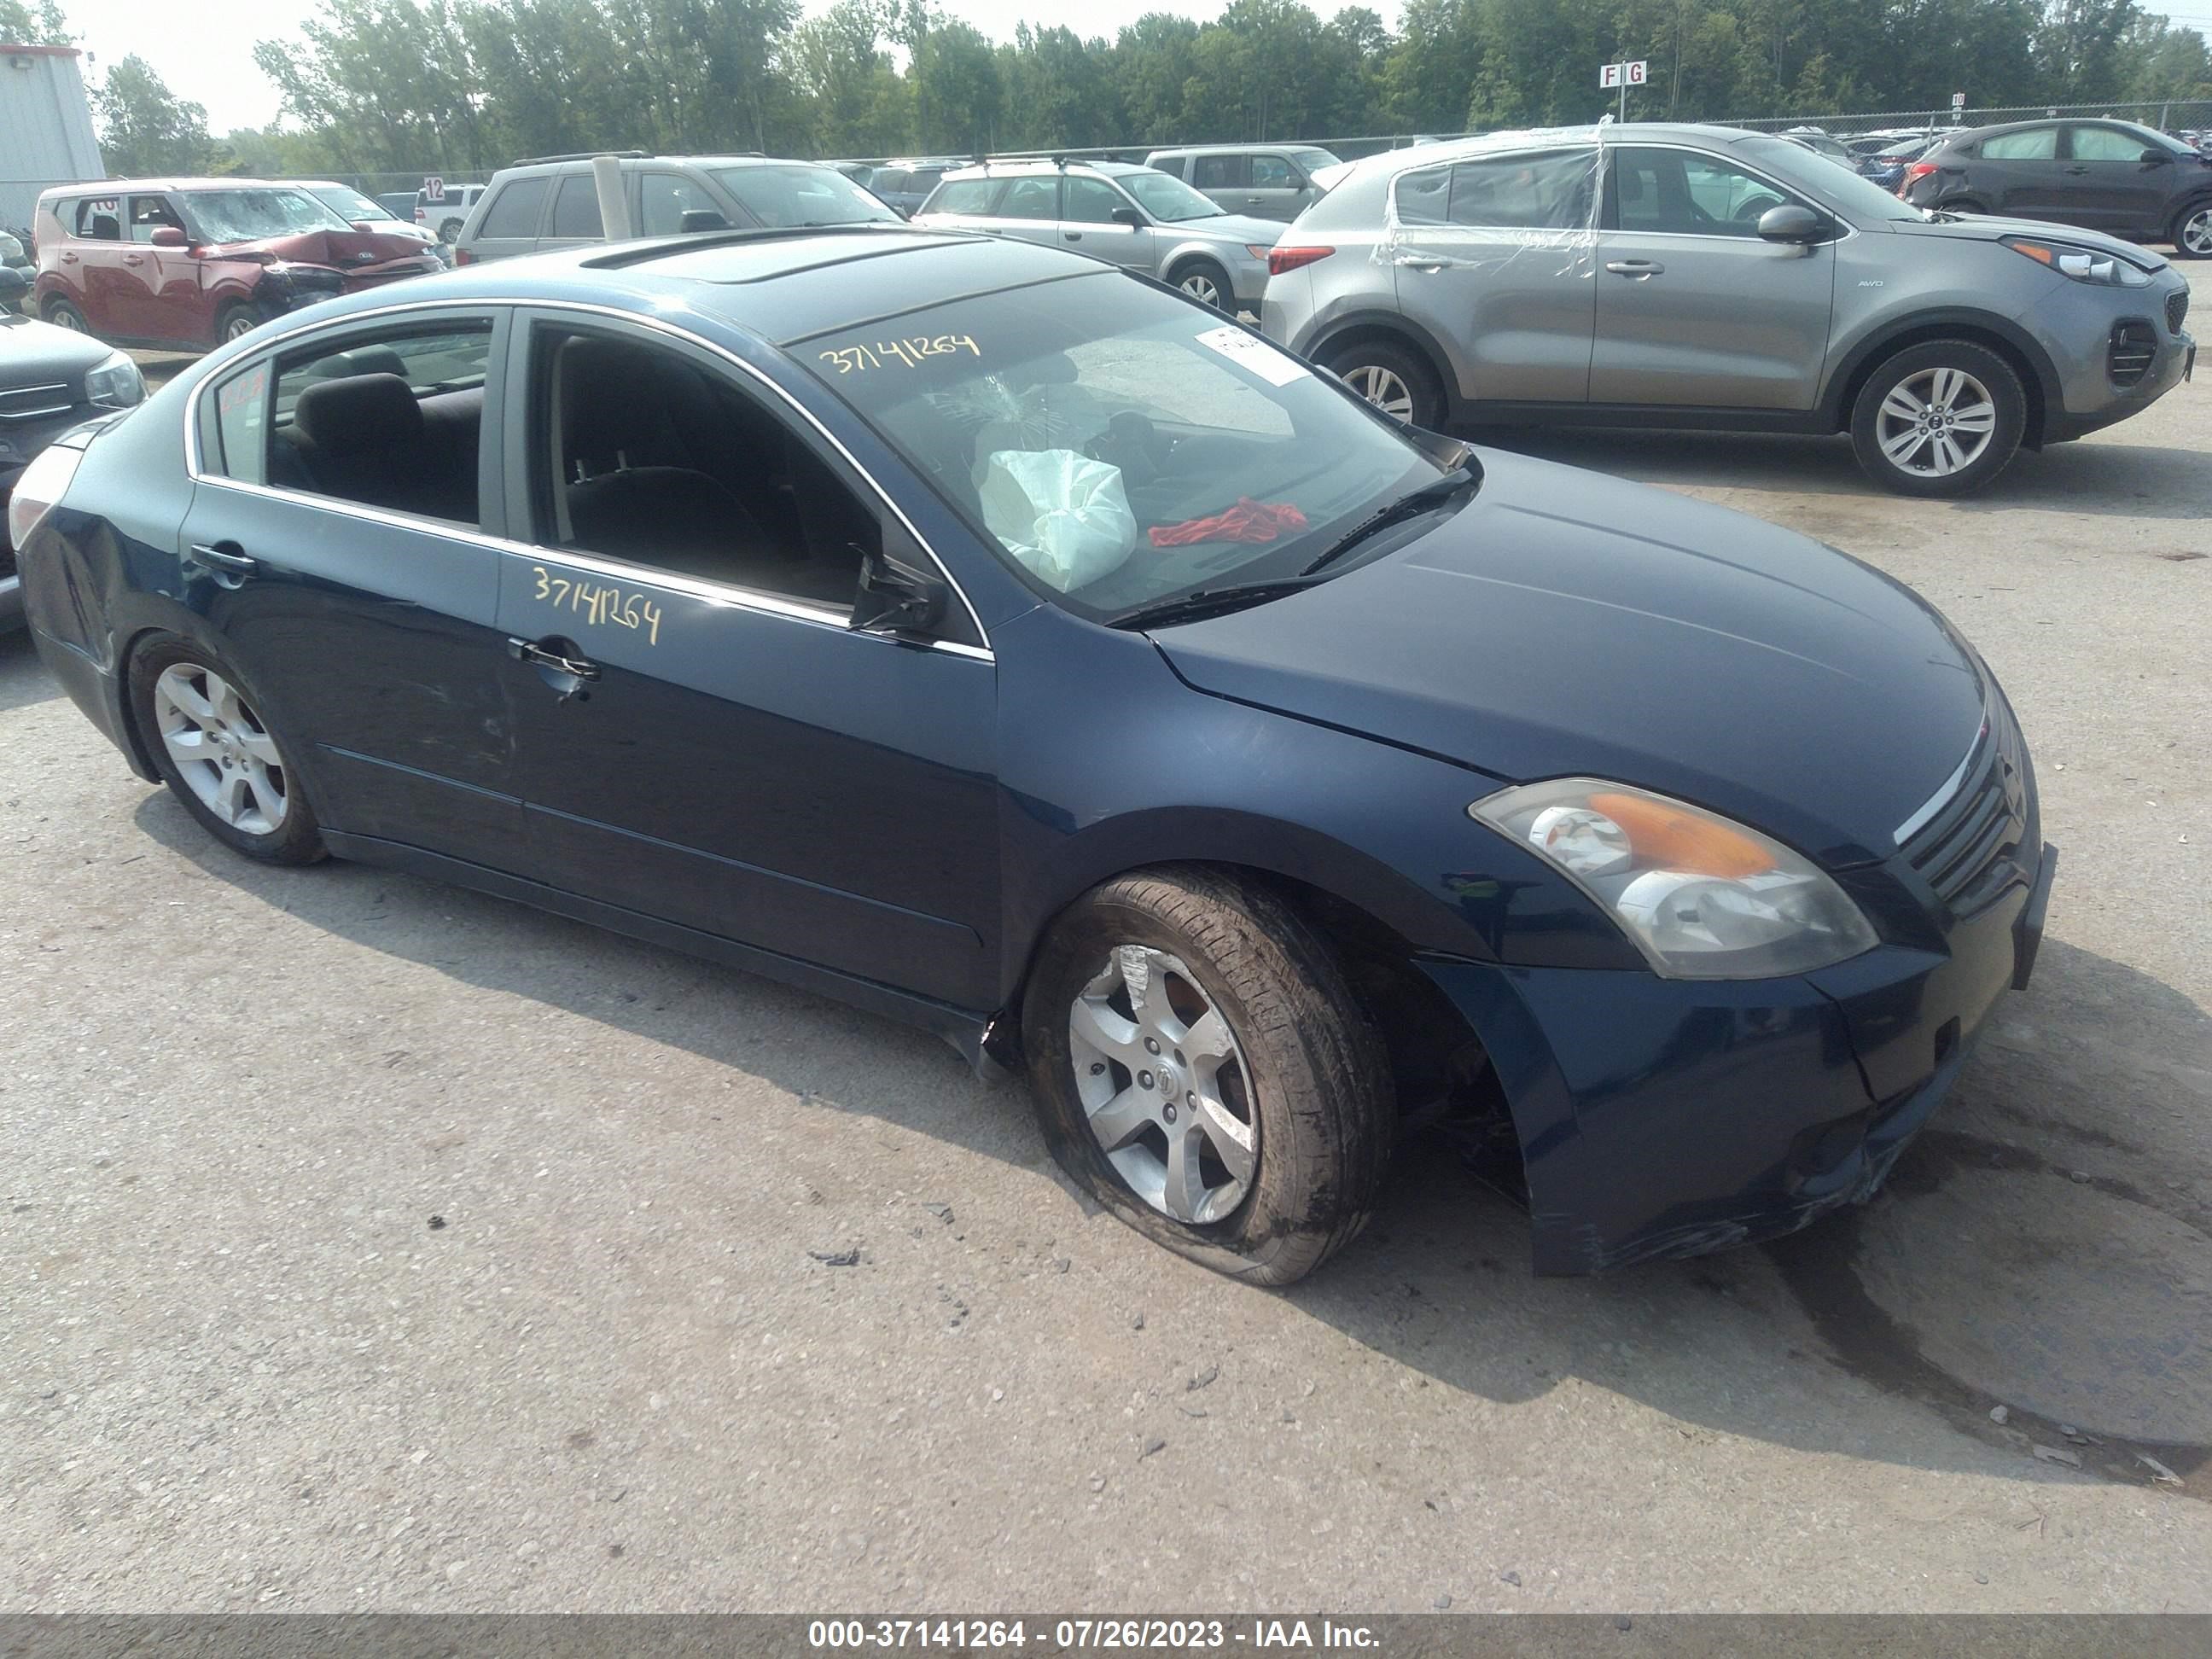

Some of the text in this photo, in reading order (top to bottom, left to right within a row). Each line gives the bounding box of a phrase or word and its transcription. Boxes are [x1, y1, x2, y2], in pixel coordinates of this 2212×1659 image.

[1605, 64, 1642, 85] F G
[427, 179, 443, 198] 12
[819, 335, 981, 374] 37141264
[533, 567, 661, 646] 37141264
